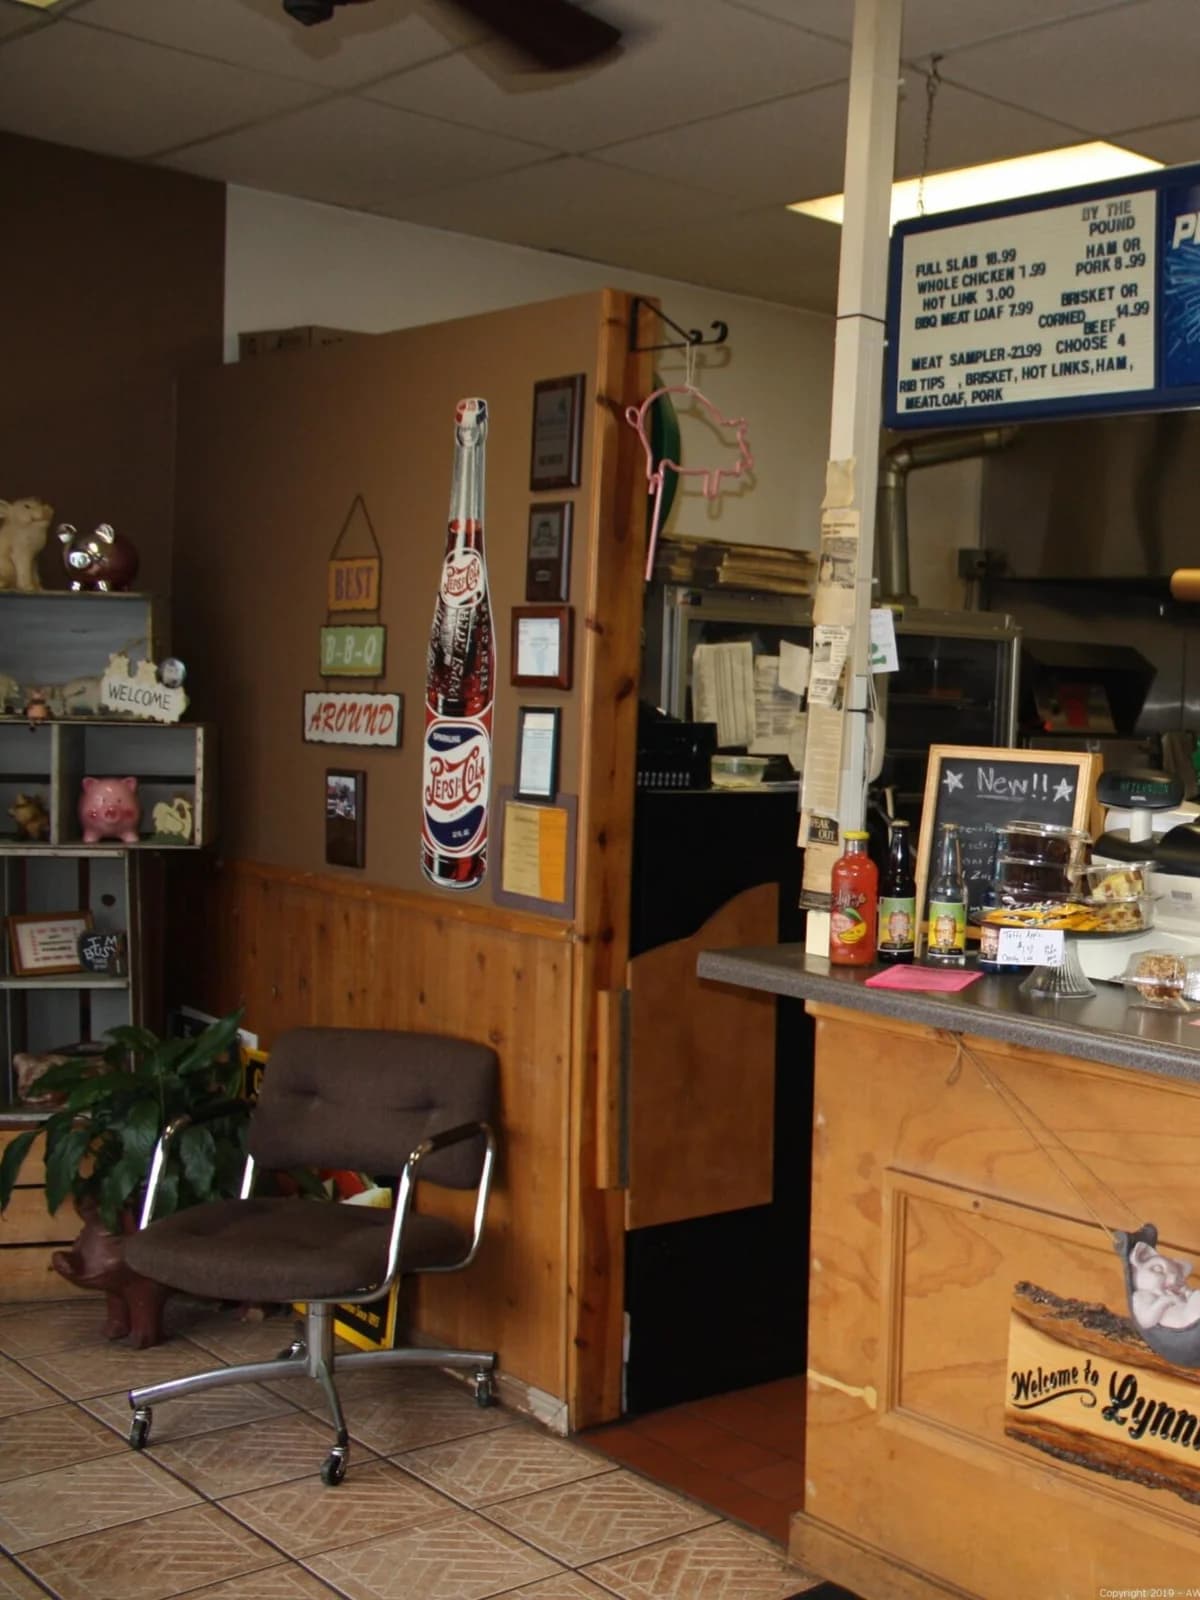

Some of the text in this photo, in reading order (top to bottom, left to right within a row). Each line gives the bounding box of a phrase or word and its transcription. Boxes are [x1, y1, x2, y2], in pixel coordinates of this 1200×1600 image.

[1082, 200, 1132, 222] BY THE
[1089, 216, 1135, 236] POUND
[1086, 237, 1141, 259] HAM OR
[916, 264, 941, 278] FULL
[946, 255, 977, 272] SLAB
[1076, 260, 1110, 276] PORK
[918, 274, 958, 295] WHOLE
[962, 267, 1015, 288] CHICKEN
[923, 286, 1015, 312] HOT LINK 3.00
[1061, 284, 1138, 307] BRISKET OR
[915, 315, 937, 330] BBQ
[941, 310, 970, 327] MEAT
[974, 304, 1004, 322] LOAF
[1039, 310, 1086, 329] CORNED
[1083, 319, 1116, 336] BEEF
[912, 355, 942, 371] MEAT
[1056, 335, 1107, 354] CHOOSE
[1117, 333, 1126, 347] 4
[899, 378, 917, 393] RIB
[920, 376, 944, 391] TIPS
[1022, 365, 1047, 380] HOT
[971, 388, 1003, 403] PORK
[335, 566, 373, 601] BEST
[108, 683, 171, 711] WELCOME
[309, 702, 394, 736] AROUND
[976, 766, 1048, 800] New!!
[1012, 1359, 1099, 1400] Welcome to
